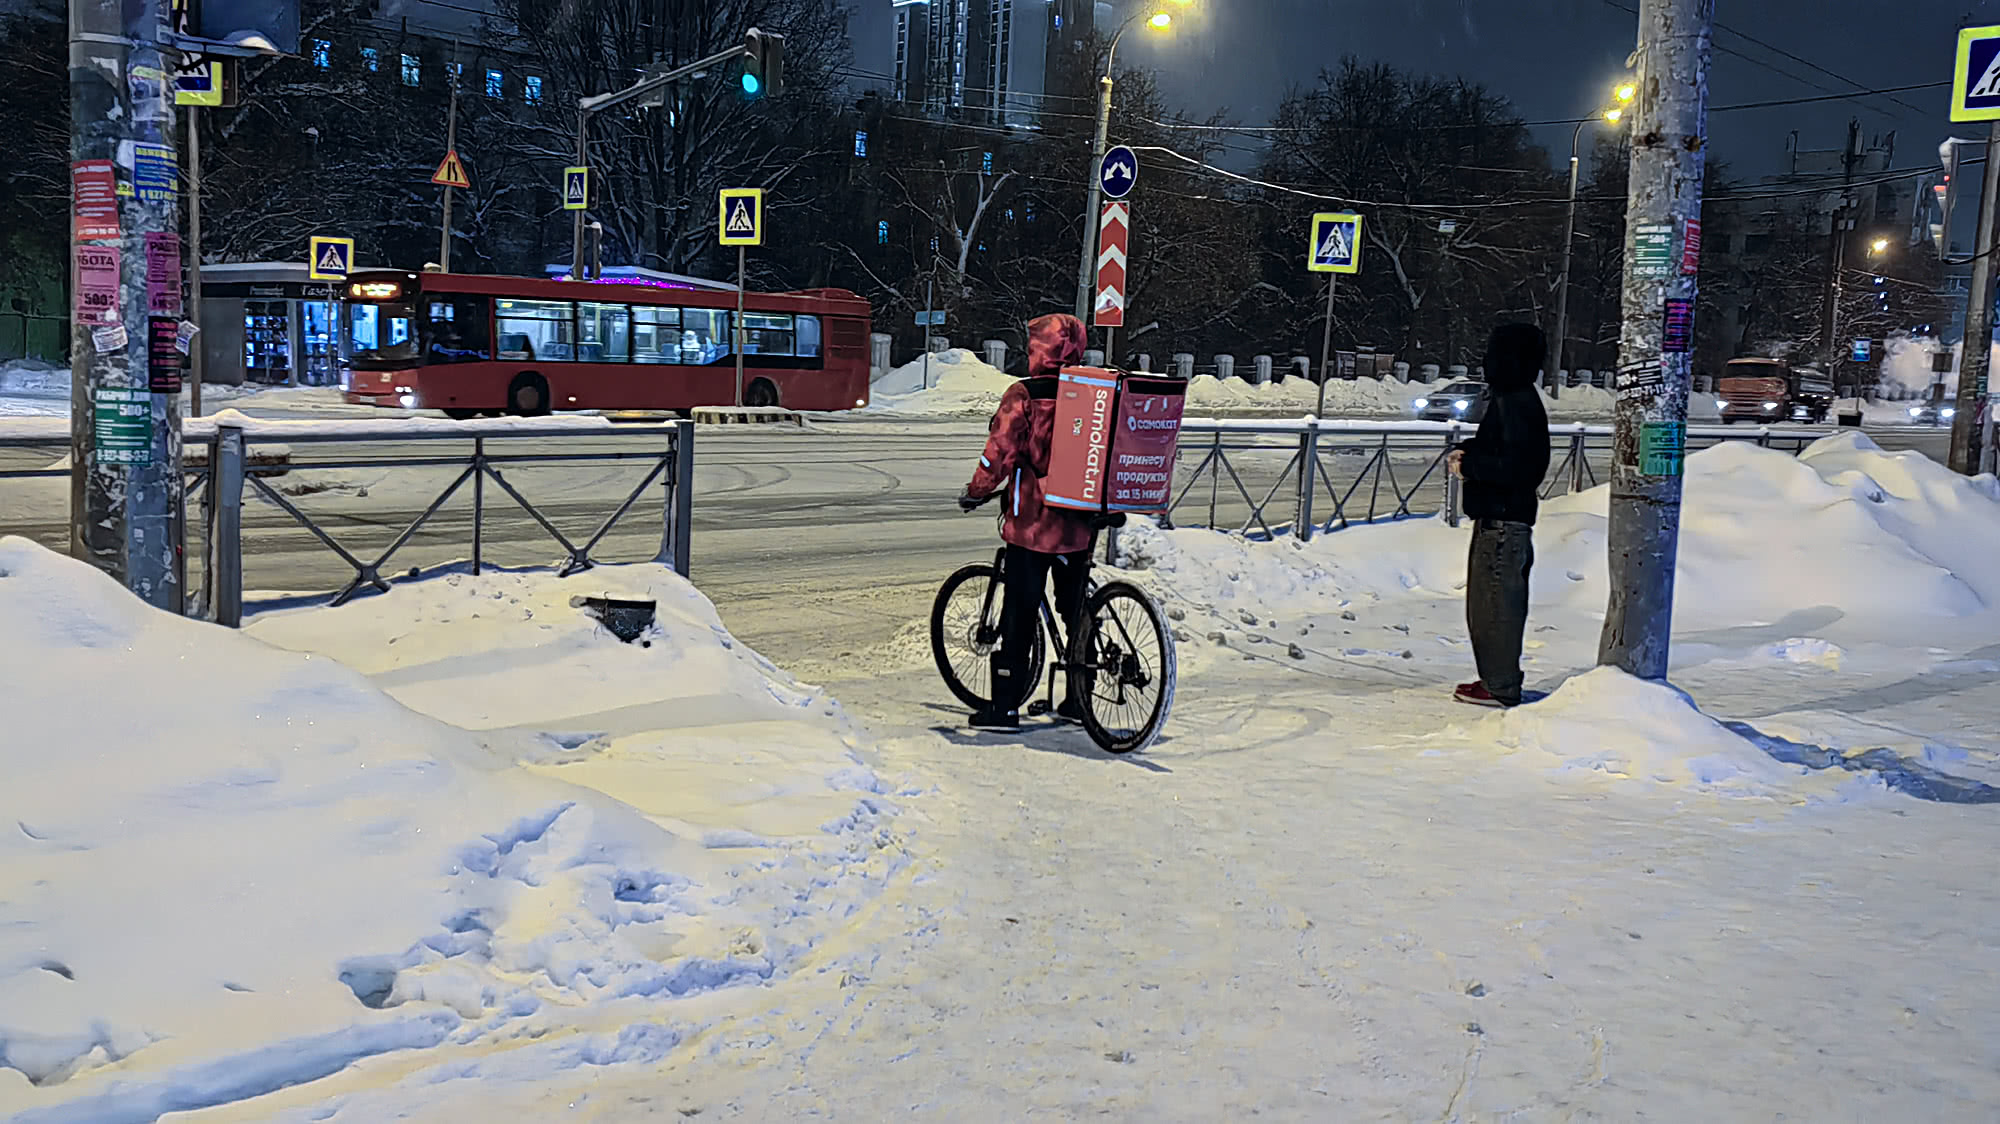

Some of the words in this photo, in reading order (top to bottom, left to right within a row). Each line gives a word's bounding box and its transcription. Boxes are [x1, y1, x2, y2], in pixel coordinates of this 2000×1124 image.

[1137, 419, 1178, 430] самокат
[1083, 389, 1108, 499] samokat.ru
[1119, 454, 1166, 468] принесу
[1116, 471, 1169, 485] продукты
[1116, 489, 1130, 499] за
[1131, 488, 1141, 499] 15
